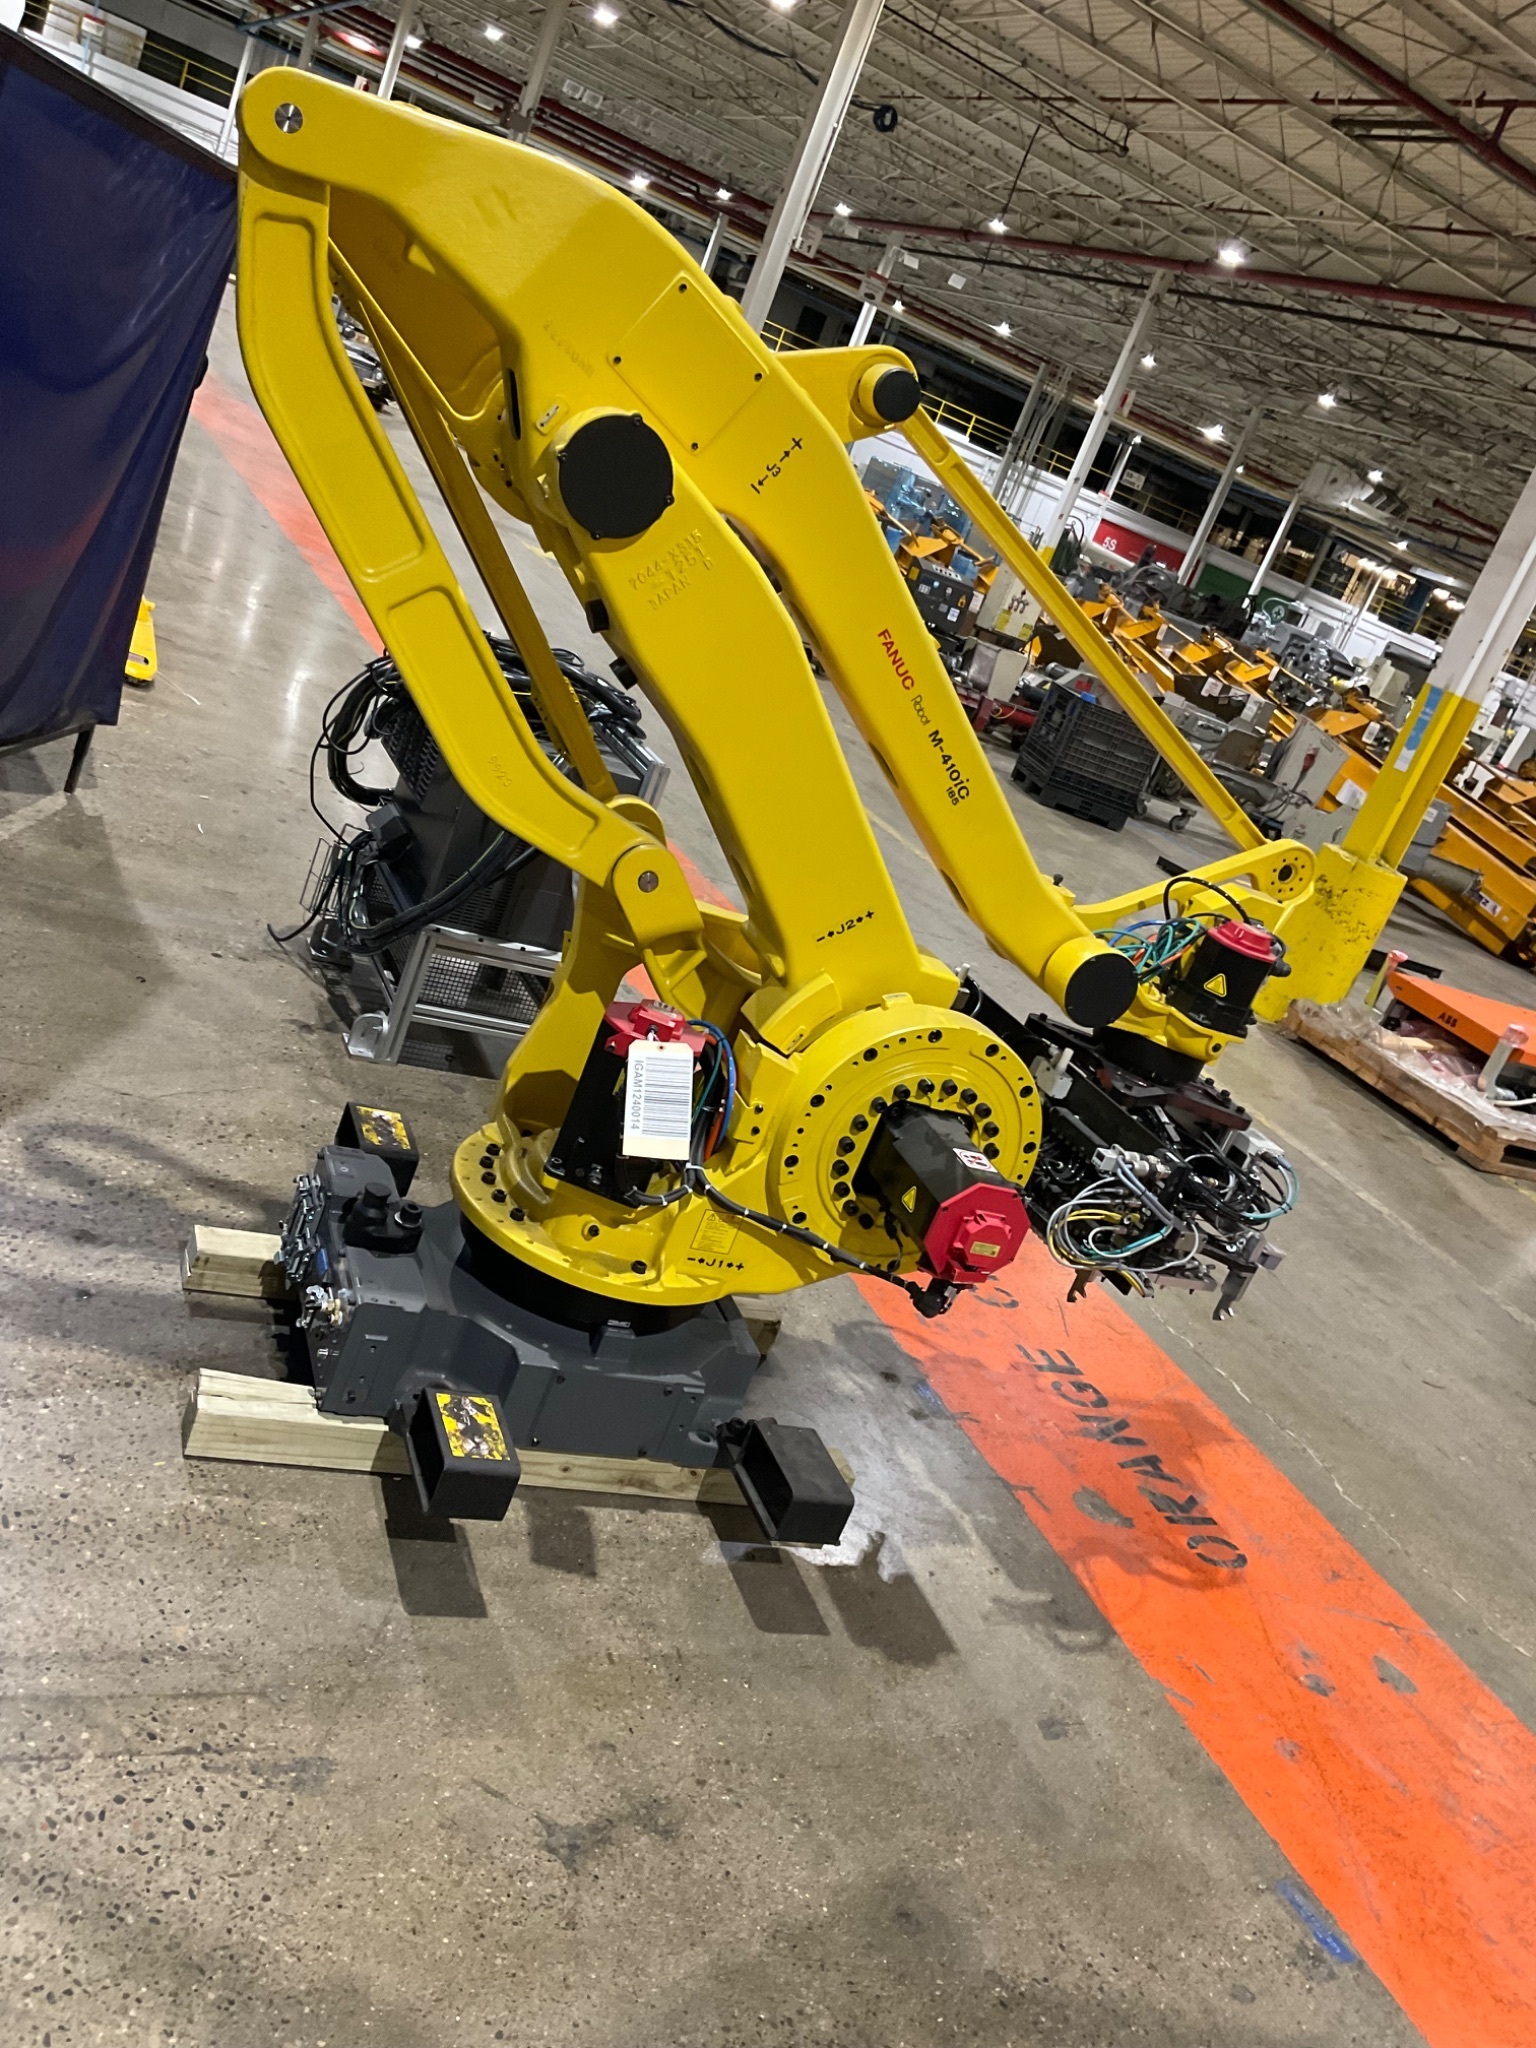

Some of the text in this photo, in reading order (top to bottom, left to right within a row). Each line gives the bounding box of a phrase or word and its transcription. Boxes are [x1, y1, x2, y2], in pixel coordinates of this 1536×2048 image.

[1102, 536, 1118, 551] 5S
[877, 628, 970, 800] FANUC Robot M-410iC
[1437, 1011, 1458, 1028] ABB
[630, 1059, 644, 1130] IGAM1240014
[1015, 1343, 1248, 1569] ORANGE
